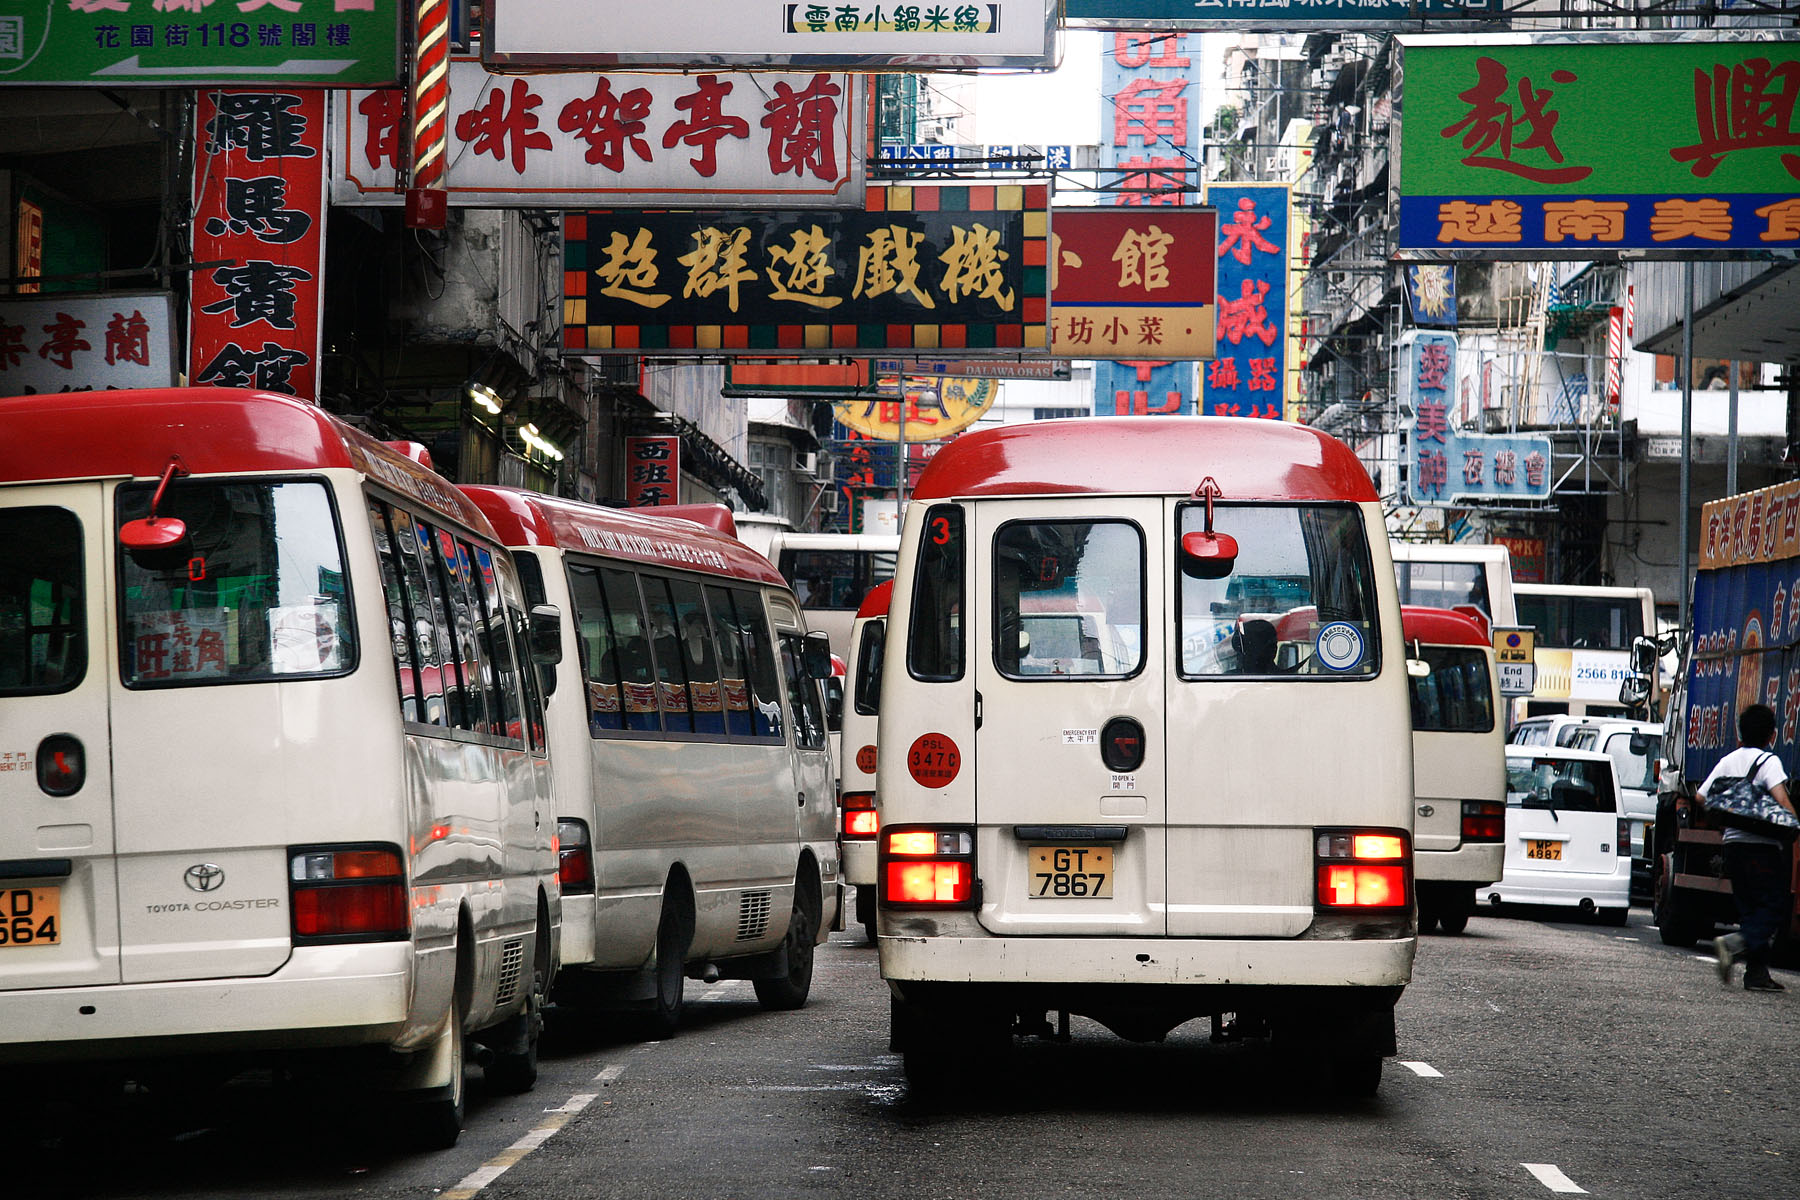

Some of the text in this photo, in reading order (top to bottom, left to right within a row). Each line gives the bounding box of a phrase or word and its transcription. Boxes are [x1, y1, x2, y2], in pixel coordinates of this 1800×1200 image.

[805, 4, 979, 33] 雲南小鍋米線
[95, 23, 351, 47] 花園街118號閣樓
[595, 223, 1016, 312] 超群遊戲機
[1017, 367, 1050, 377] ORAS
[632, 440, 672, 506] 西班牙
[932, 517, 950, 545] 3
[1504, 666, 1522, 675] End
[922, 740, 944, 749] PSL
[912, 751, 956, 767] 347C
[1536, 840, 1552, 849] MP
[1054, 849, 1088, 872] GT
[1528, 850, 1560, 860] 4887
[1036, 873, 1105, 896] 7867
[146, 898, 280, 913] TOYOTA COASTER
